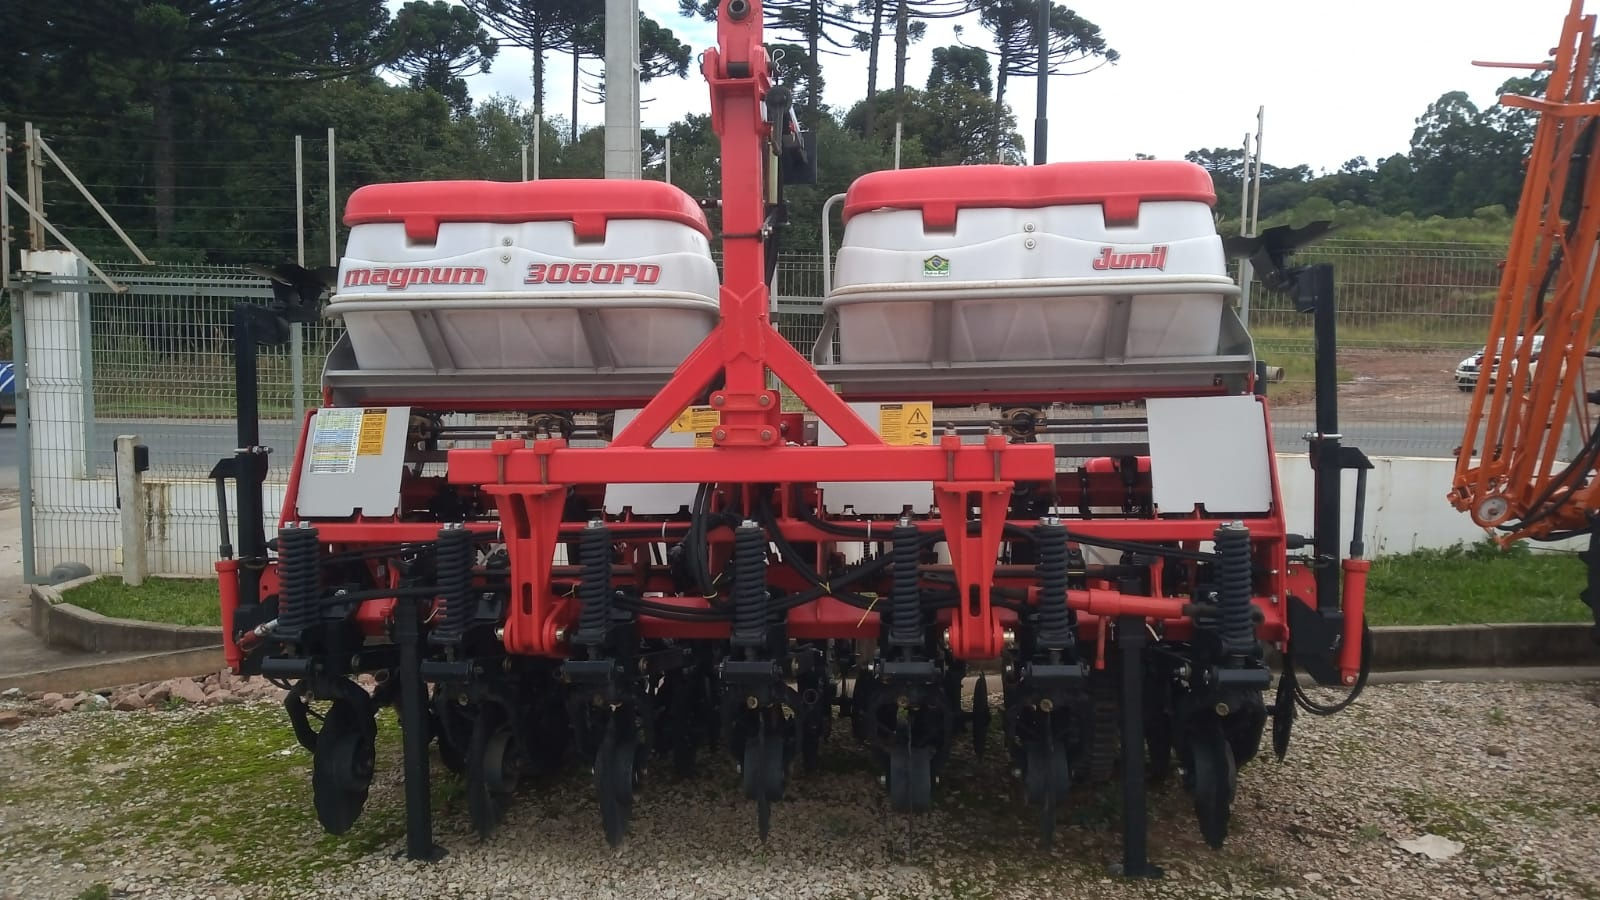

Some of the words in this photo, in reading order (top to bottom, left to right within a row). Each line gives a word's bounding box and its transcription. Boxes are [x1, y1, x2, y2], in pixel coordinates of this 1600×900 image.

[1093, 245, 1168, 271] Jumil
[344, 267, 487, 289] magnum
[524, 262, 661, 284] 3060PD
